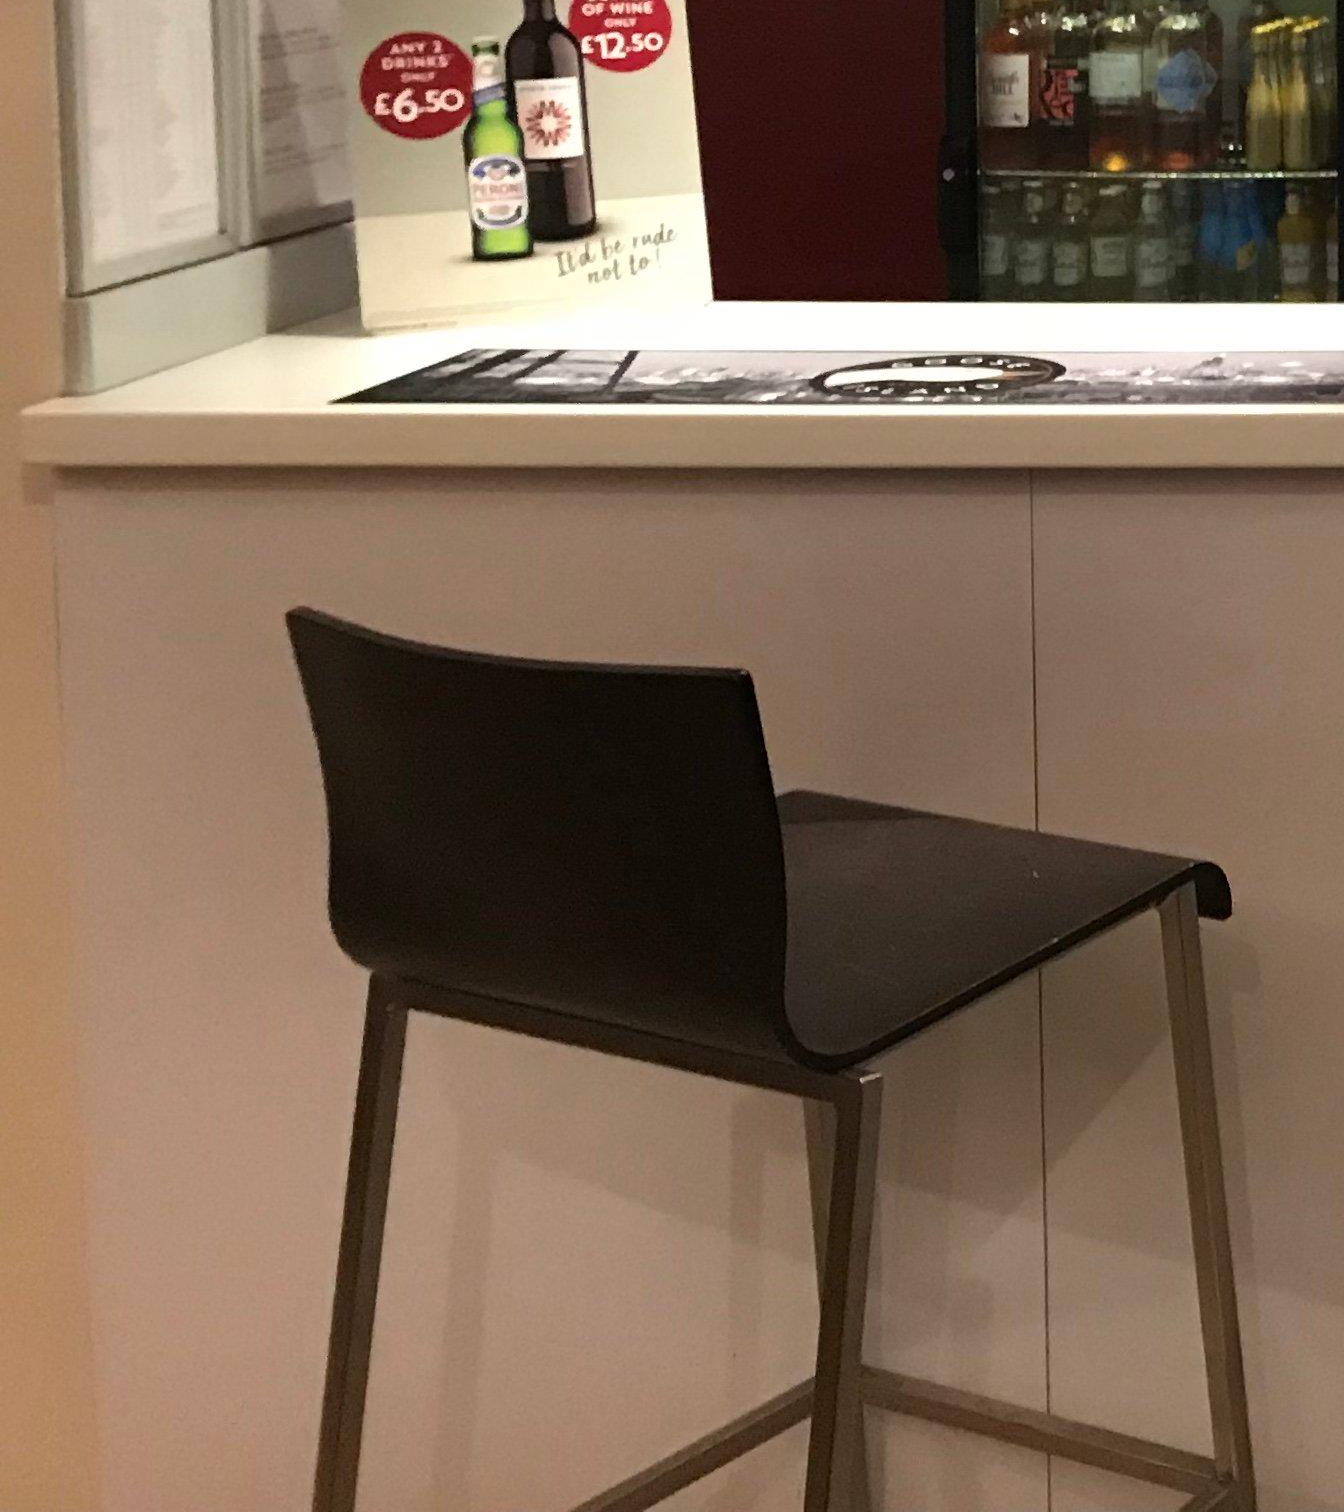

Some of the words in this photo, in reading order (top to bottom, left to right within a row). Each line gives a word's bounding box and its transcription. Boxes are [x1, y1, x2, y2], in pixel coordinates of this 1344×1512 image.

[581, 3, 604, 16] OF
[610, 1, 654, 15] WINE
[389, 41, 426, 55] ANY
[580, 31, 664, 60] £12.50
[373, 87, 465, 123] £6.50
[600, 236, 622, 260] be
[632, 223, 677, 248] rude
[588, 259, 622, 284] not
